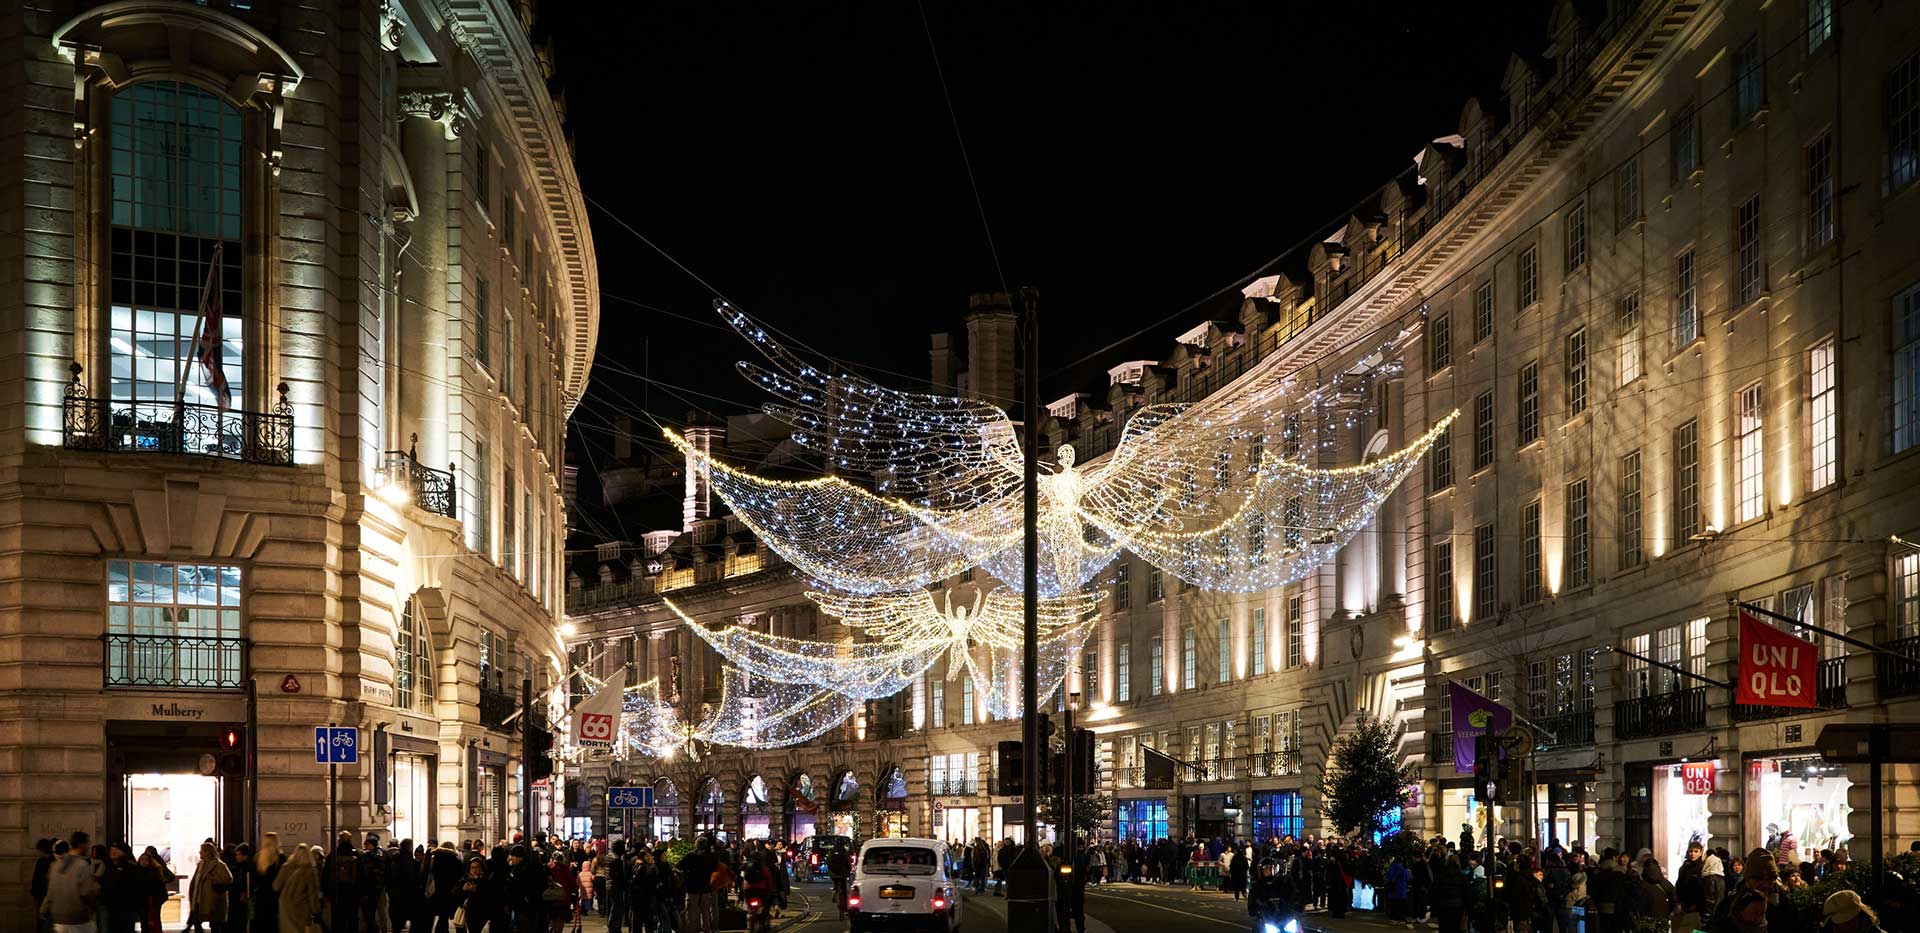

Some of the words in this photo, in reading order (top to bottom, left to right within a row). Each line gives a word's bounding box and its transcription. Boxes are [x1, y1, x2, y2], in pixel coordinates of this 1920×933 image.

[1752, 643, 1799, 670] UNI
[1751, 672, 1802, 699] QLO
[151, 703, 204, 720] Mulberry
[579, 739, 611, 748] NORTH
[1686, 767, 1709, 779] UNI
[1686, 779, 1712, 794] QLO
[284, 822, 309, 833] 1971
